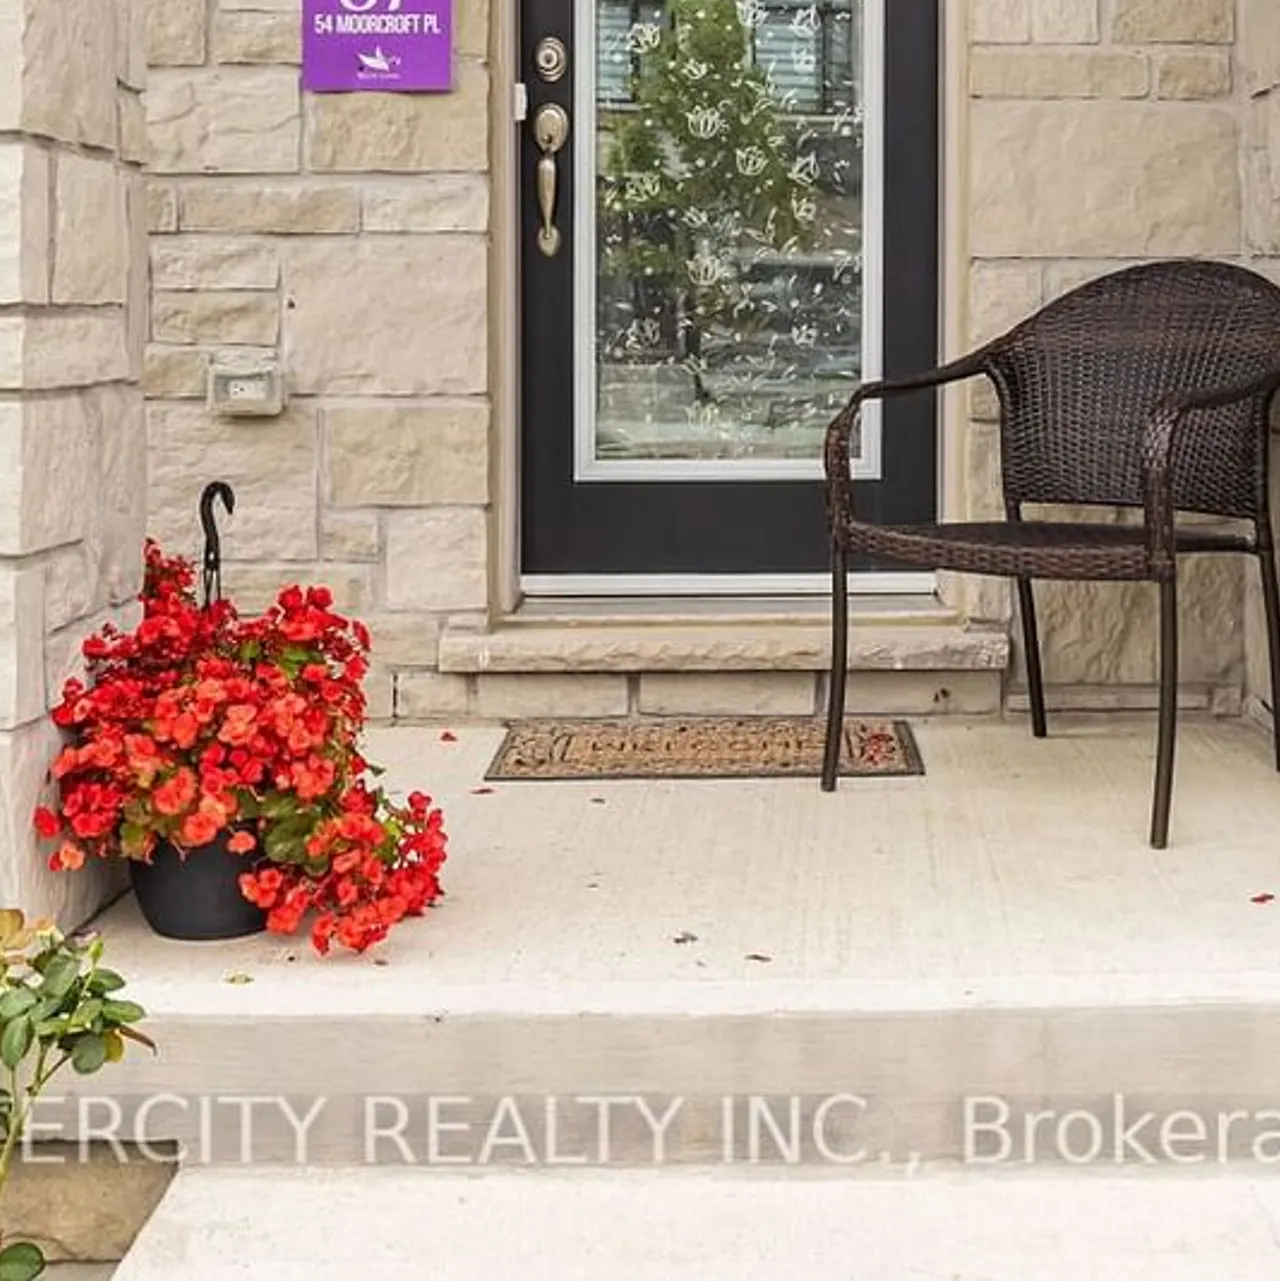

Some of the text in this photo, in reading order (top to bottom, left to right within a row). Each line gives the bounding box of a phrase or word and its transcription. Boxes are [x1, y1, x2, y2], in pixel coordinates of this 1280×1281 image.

[314, 13, 442, 34] 54 MOORCROFT PL
